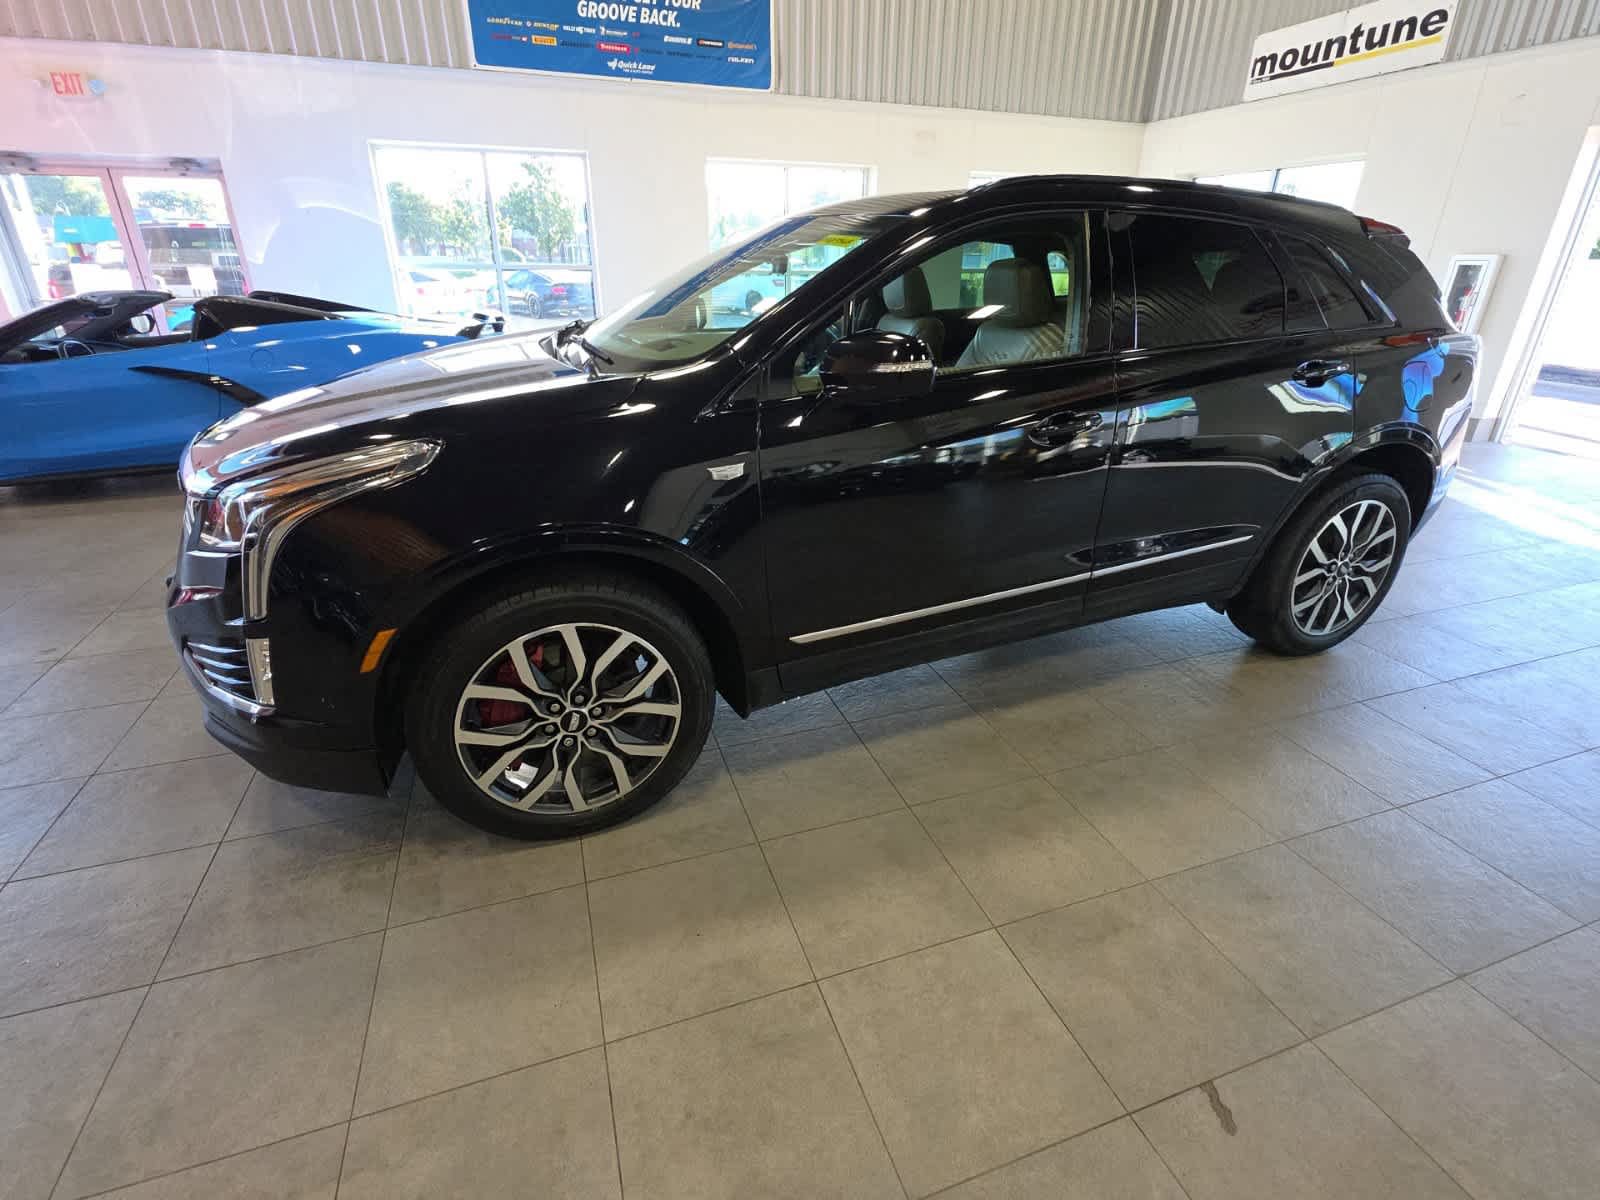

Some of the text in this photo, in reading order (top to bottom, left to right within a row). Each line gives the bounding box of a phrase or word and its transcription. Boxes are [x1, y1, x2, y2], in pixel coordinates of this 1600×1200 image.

[577, 1, 681, 28] GROOVE BACK.
[1250, 8, 1450, 78] mountune
[49, 72, 85, 96] EXIT
